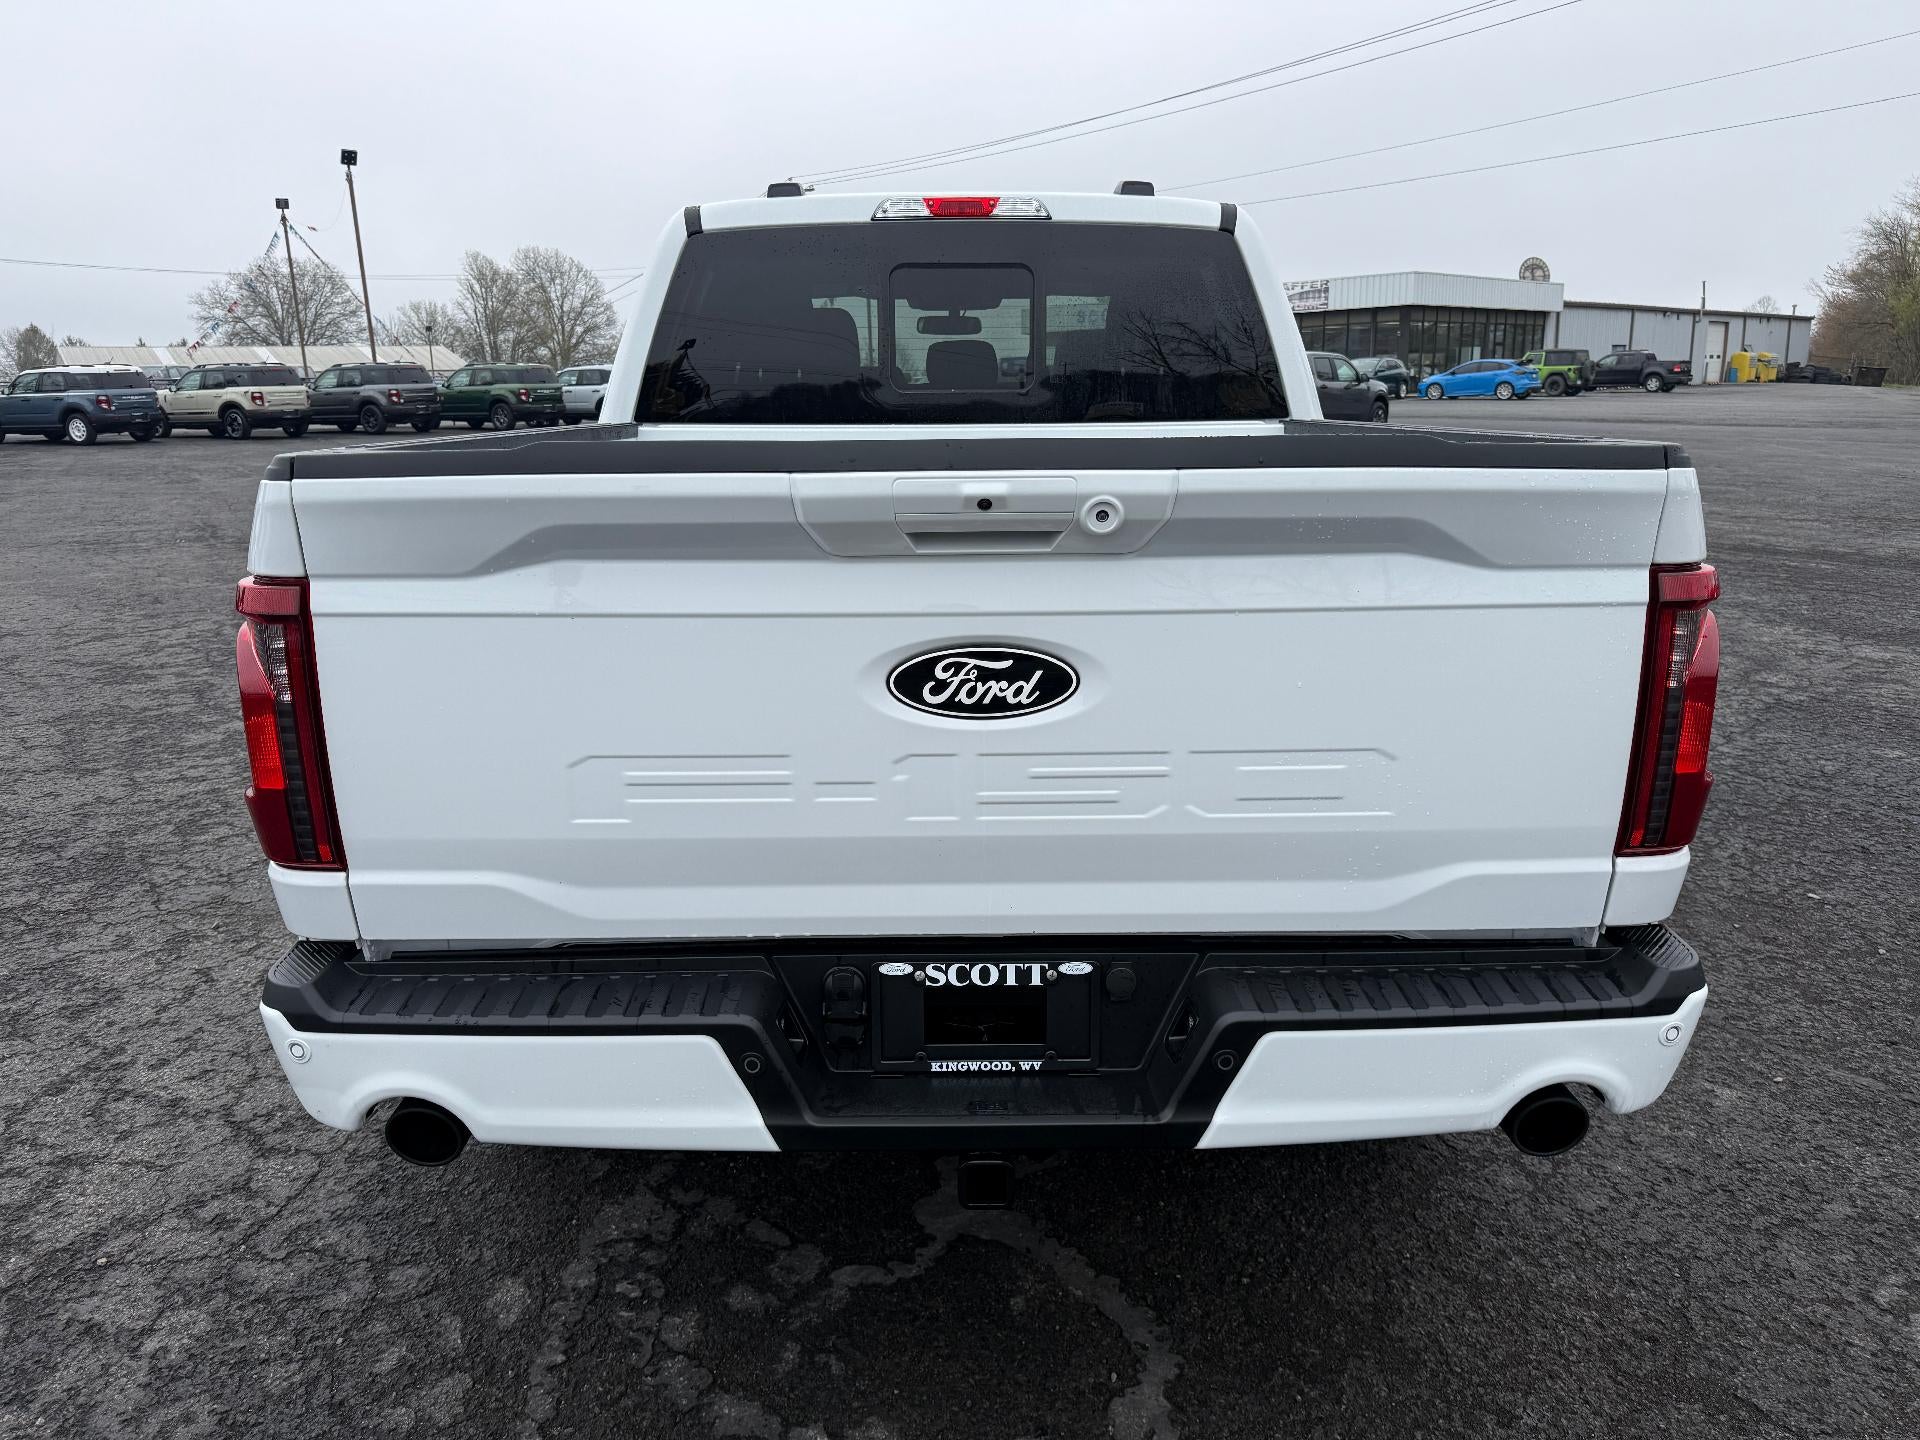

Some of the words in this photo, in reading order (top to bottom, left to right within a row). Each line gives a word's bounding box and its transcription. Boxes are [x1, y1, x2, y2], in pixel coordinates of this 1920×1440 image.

[922, 657, 1044, 705] Ford
[566, 748, 1397, 823] F-150
[925, 963, 1049, 987] SCOTT
[930, 1061, 1016, 1072] KINGWOOD,
[1019, 1061, 1043, 1071] WV
